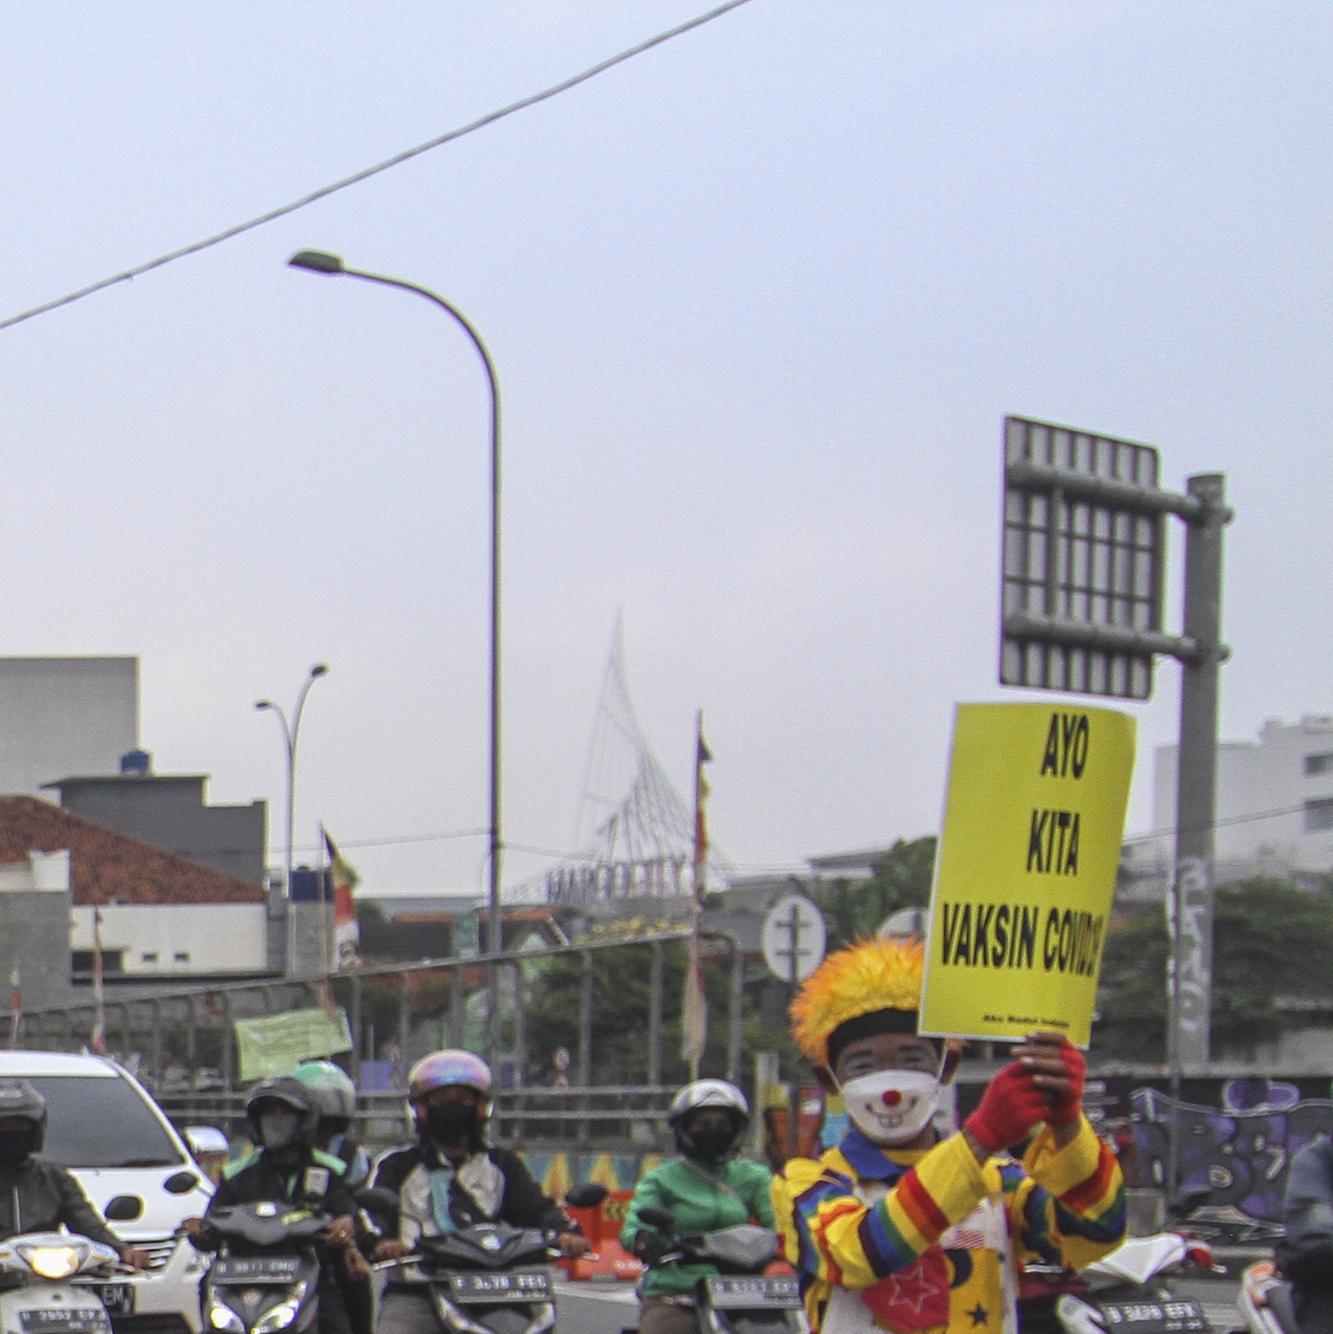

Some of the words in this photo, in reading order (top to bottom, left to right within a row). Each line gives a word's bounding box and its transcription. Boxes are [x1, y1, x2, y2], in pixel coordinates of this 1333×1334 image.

[1040, 712, 1090, 780] AYO
[1026, 808, 1081, 877] KITA
[942, 903, 1039, 970] VAKSIN
